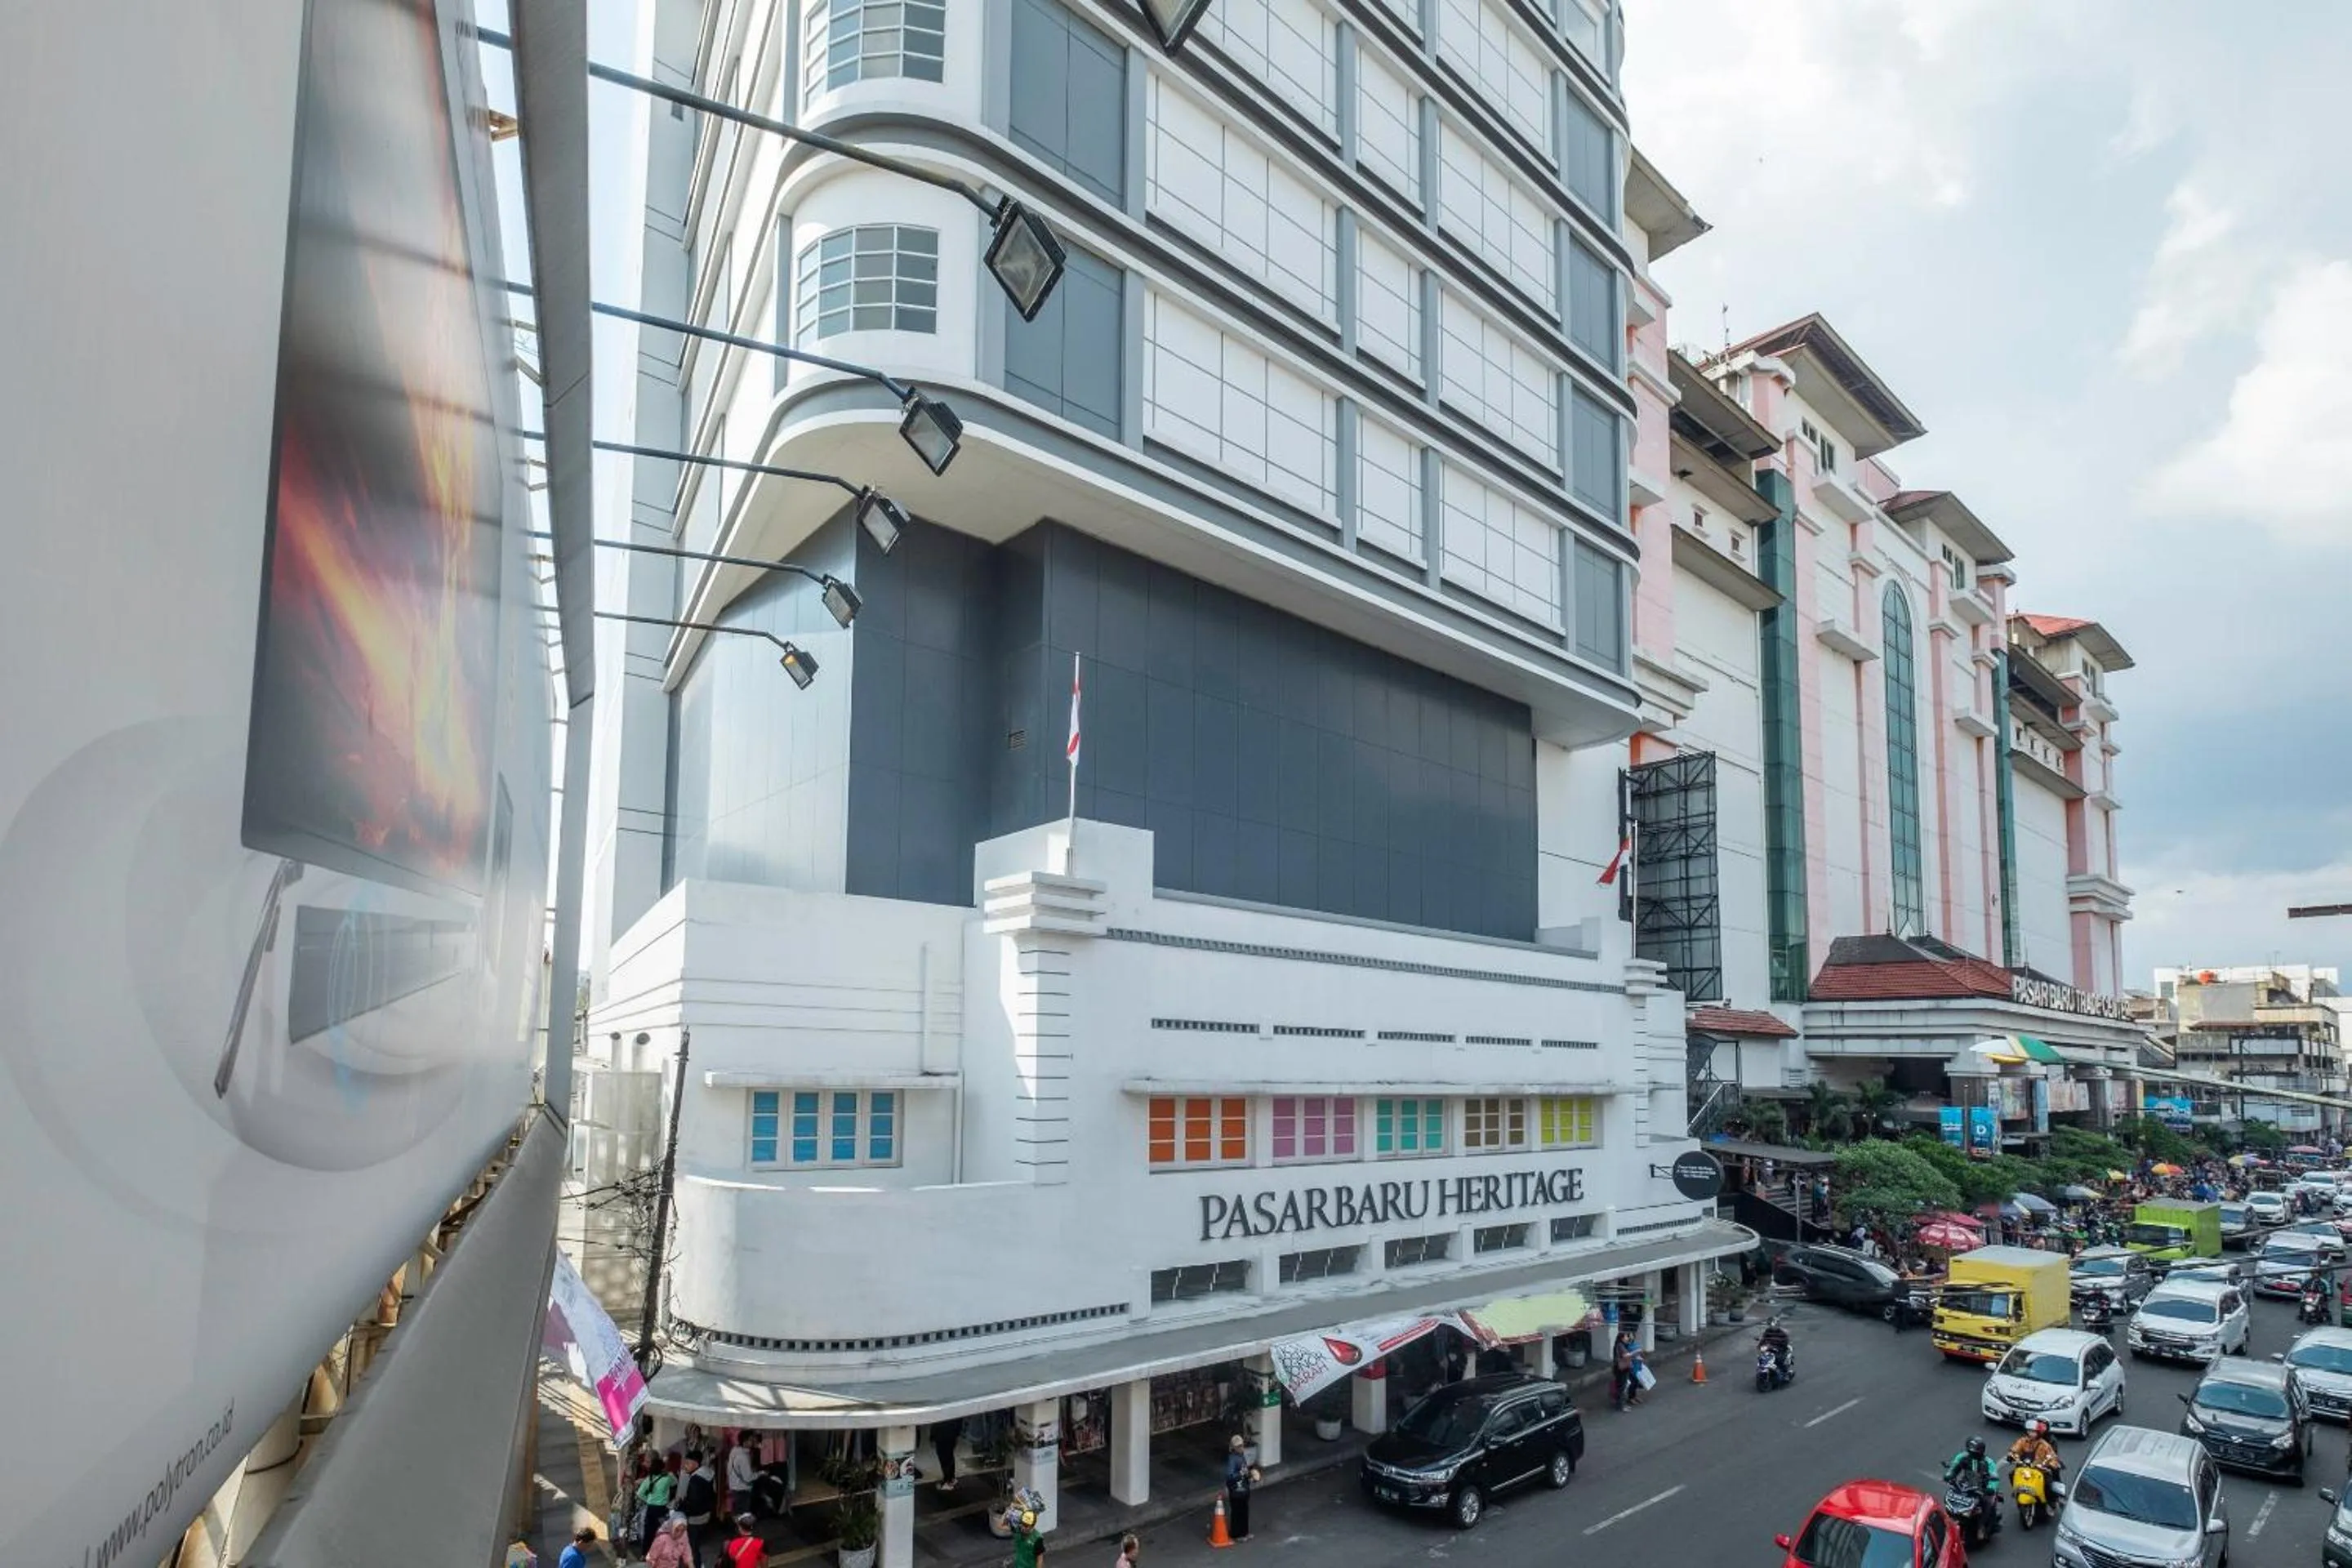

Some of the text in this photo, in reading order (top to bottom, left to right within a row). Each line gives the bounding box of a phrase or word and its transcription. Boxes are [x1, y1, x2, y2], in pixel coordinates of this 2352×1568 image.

[2012, 975, 2049, 1008] PASAR
[2049, 983, 2076, 1013] BARU
[1437, 1168, 1585, 1216] HERITAGE
